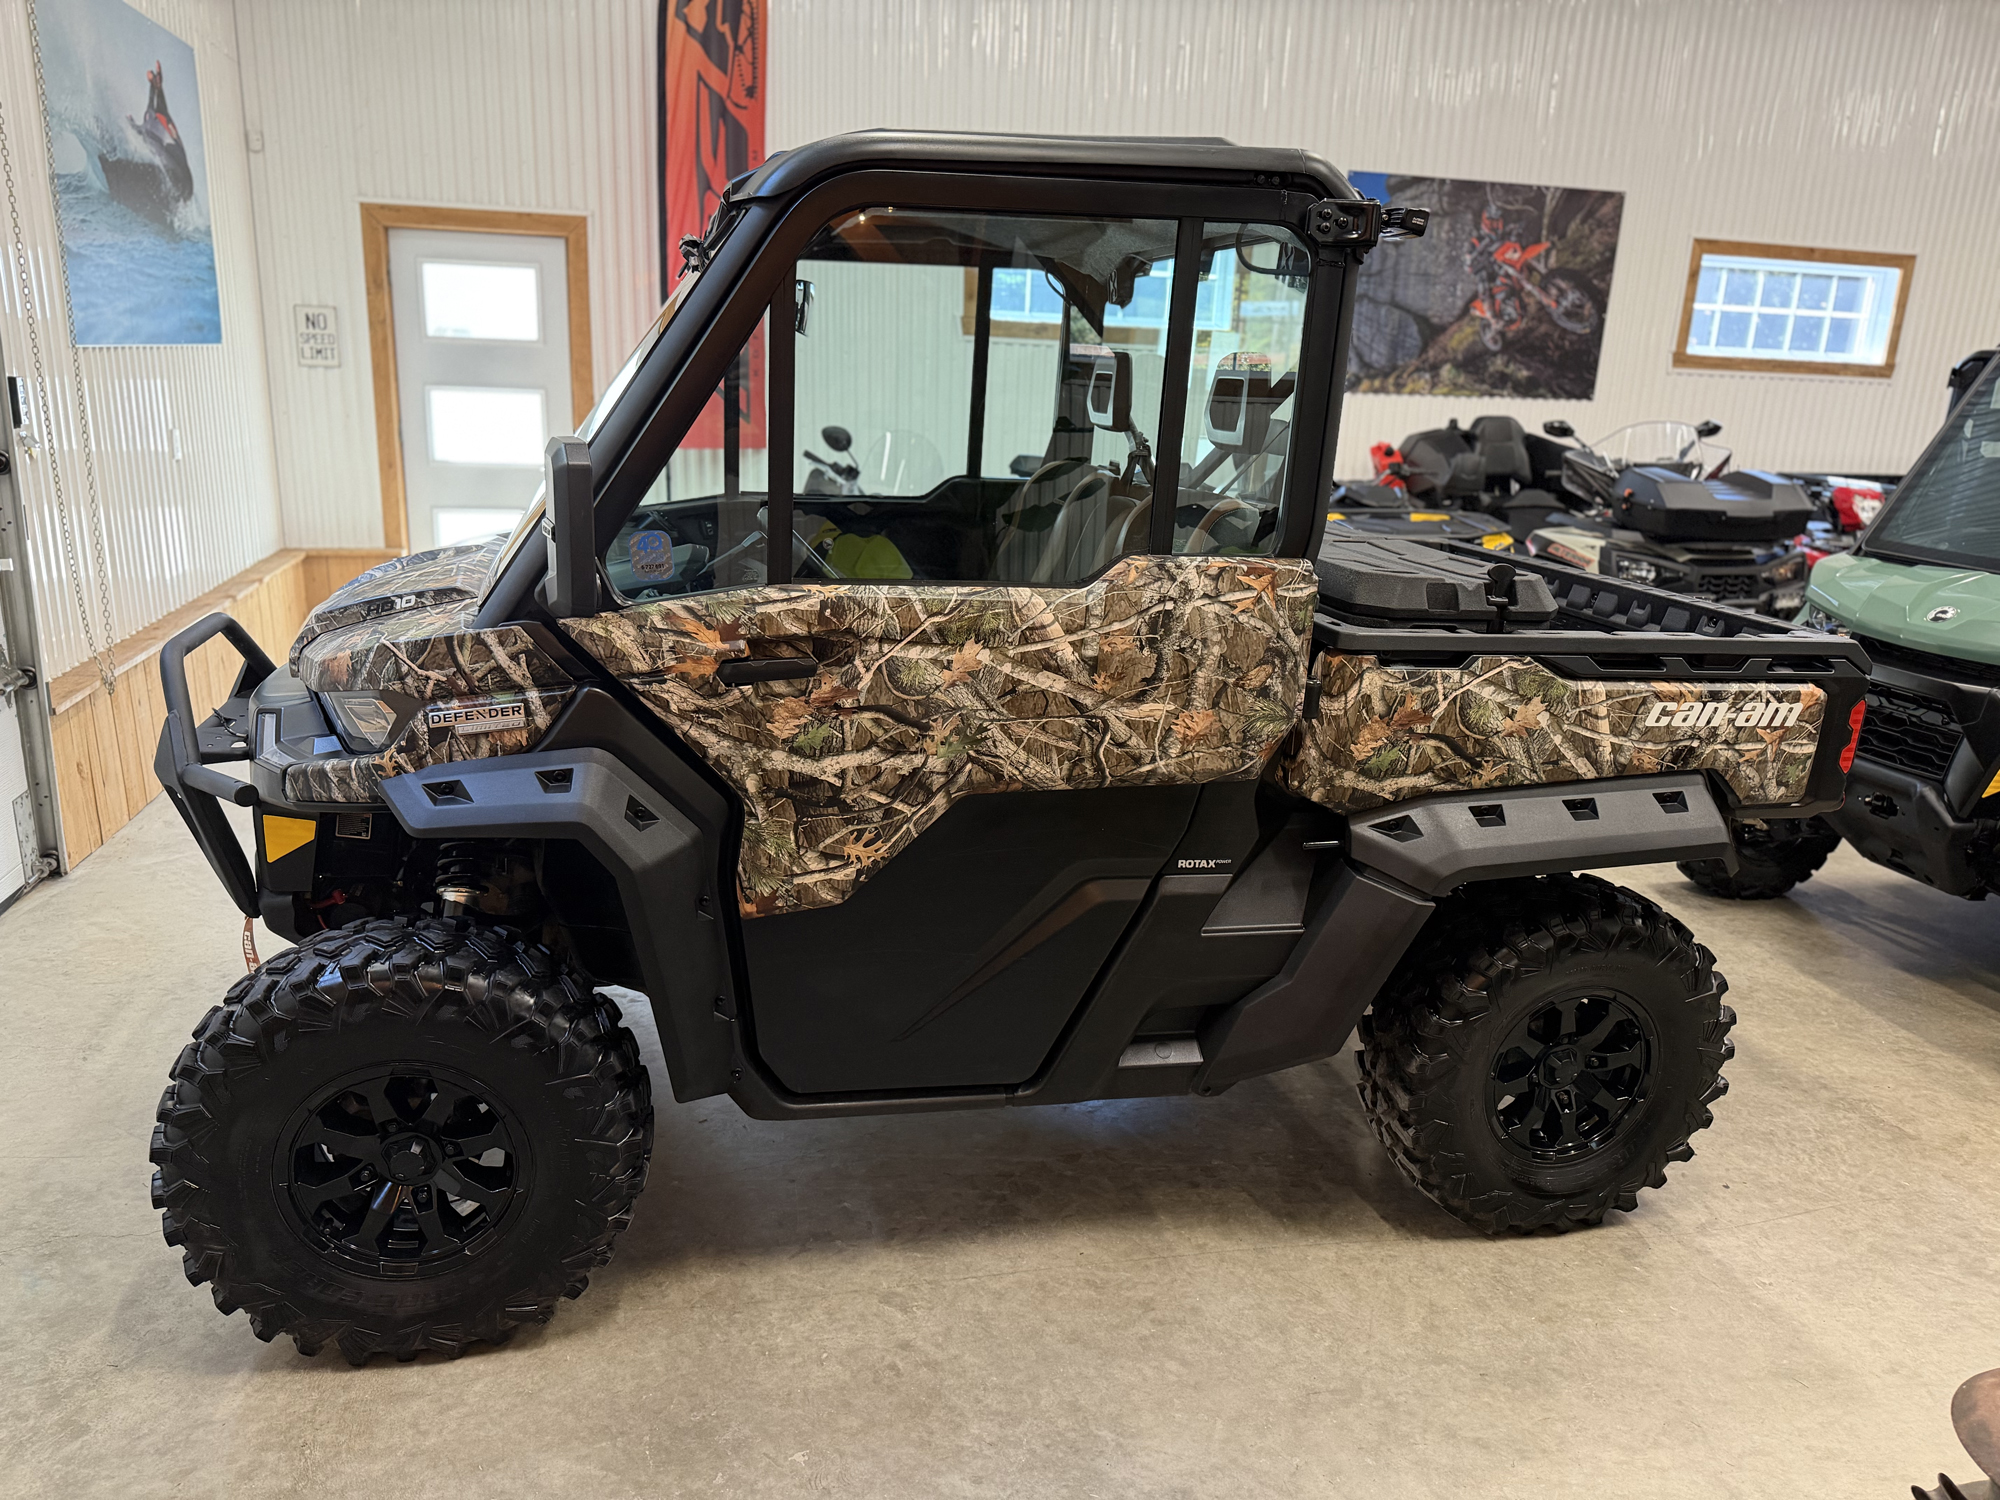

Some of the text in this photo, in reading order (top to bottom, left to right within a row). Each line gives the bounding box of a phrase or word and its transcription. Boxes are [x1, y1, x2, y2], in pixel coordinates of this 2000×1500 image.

[305, 312, 328, 331] NO
[300, 332, 336, 346] SPEED
[301, 346, 336, 360] LIMIT
[367, 594, 417, 617] HD10
[431, 705, 523, 725] DEFENDER
[1644, 701, 1804, 728] can-am
[1177, 859, 1217, 869] ROTAX
[243, 931, 258, 974] can-a
